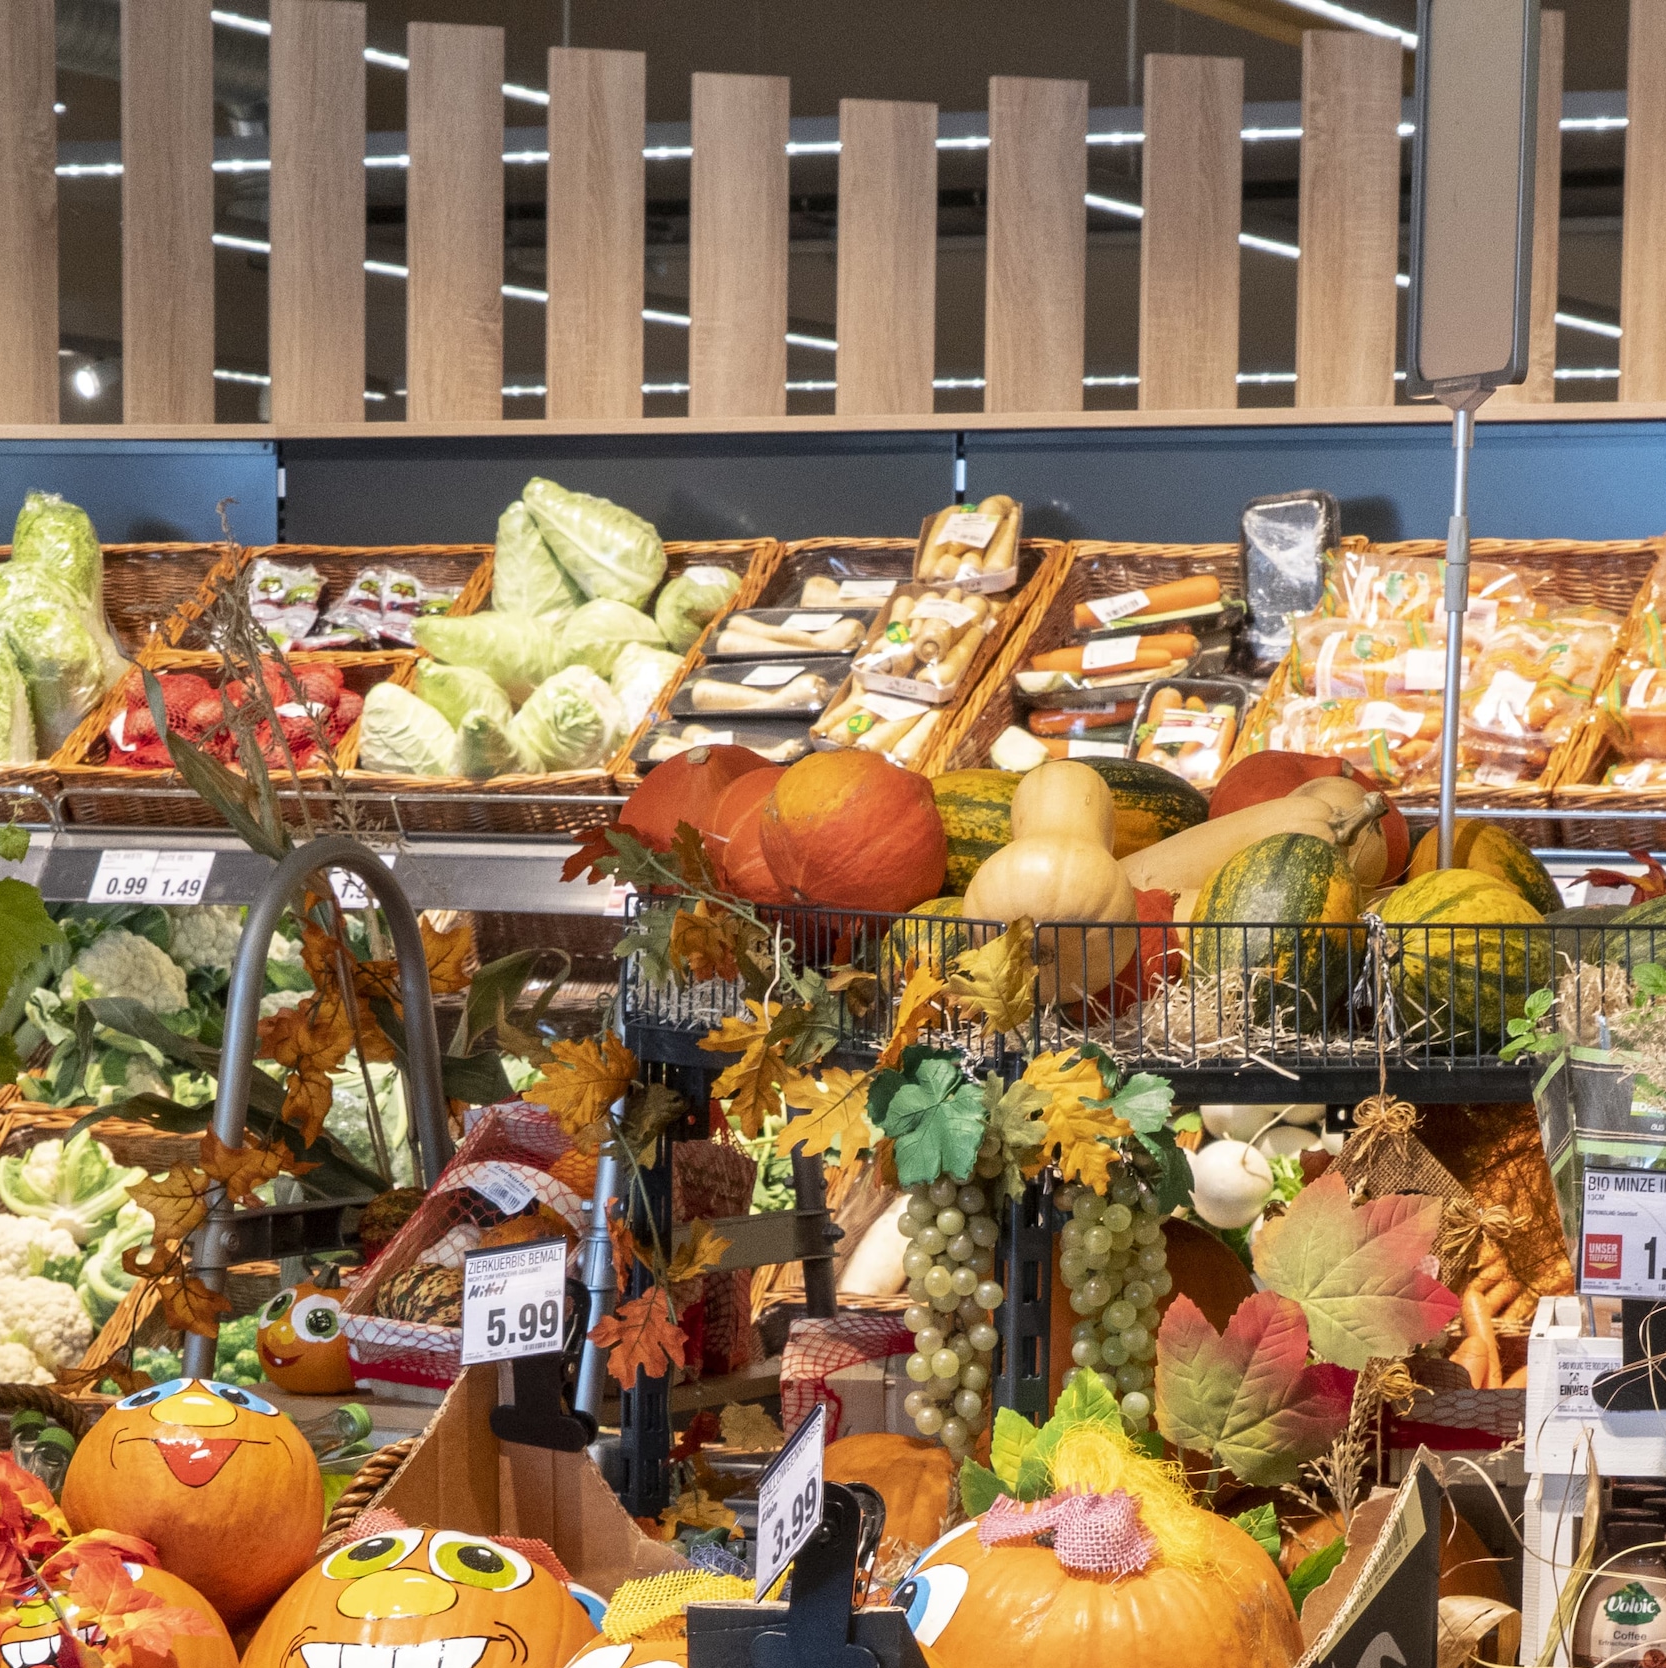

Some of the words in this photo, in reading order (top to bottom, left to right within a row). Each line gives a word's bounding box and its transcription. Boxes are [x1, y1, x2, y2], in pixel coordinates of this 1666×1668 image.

[105, 876, 148, 896] 0.99
[160, 878, 202, 897] 1.49
[1587, 1176, 1611, 1191] BIO
[1614, 1177, 1656, 1193] MINZE
[1588, 1243, 1618, 1255] UNSER
[1588, 1254, 1619, 1263] TIEFPREIS
[467, 1254, 526, 1276] ZIERKUERBIS
[527, 1247, 564, 1267] BEMALT
[486, 1299, 560, 1348] 5.99
[1559, 1384, 1589, 1396] EINWEG
[771, 1476, 818, 1566] 3.99
[1607, 1595, 1658, 1615] Volvic
[1613, 1630, 1648, 1641] Coffee
